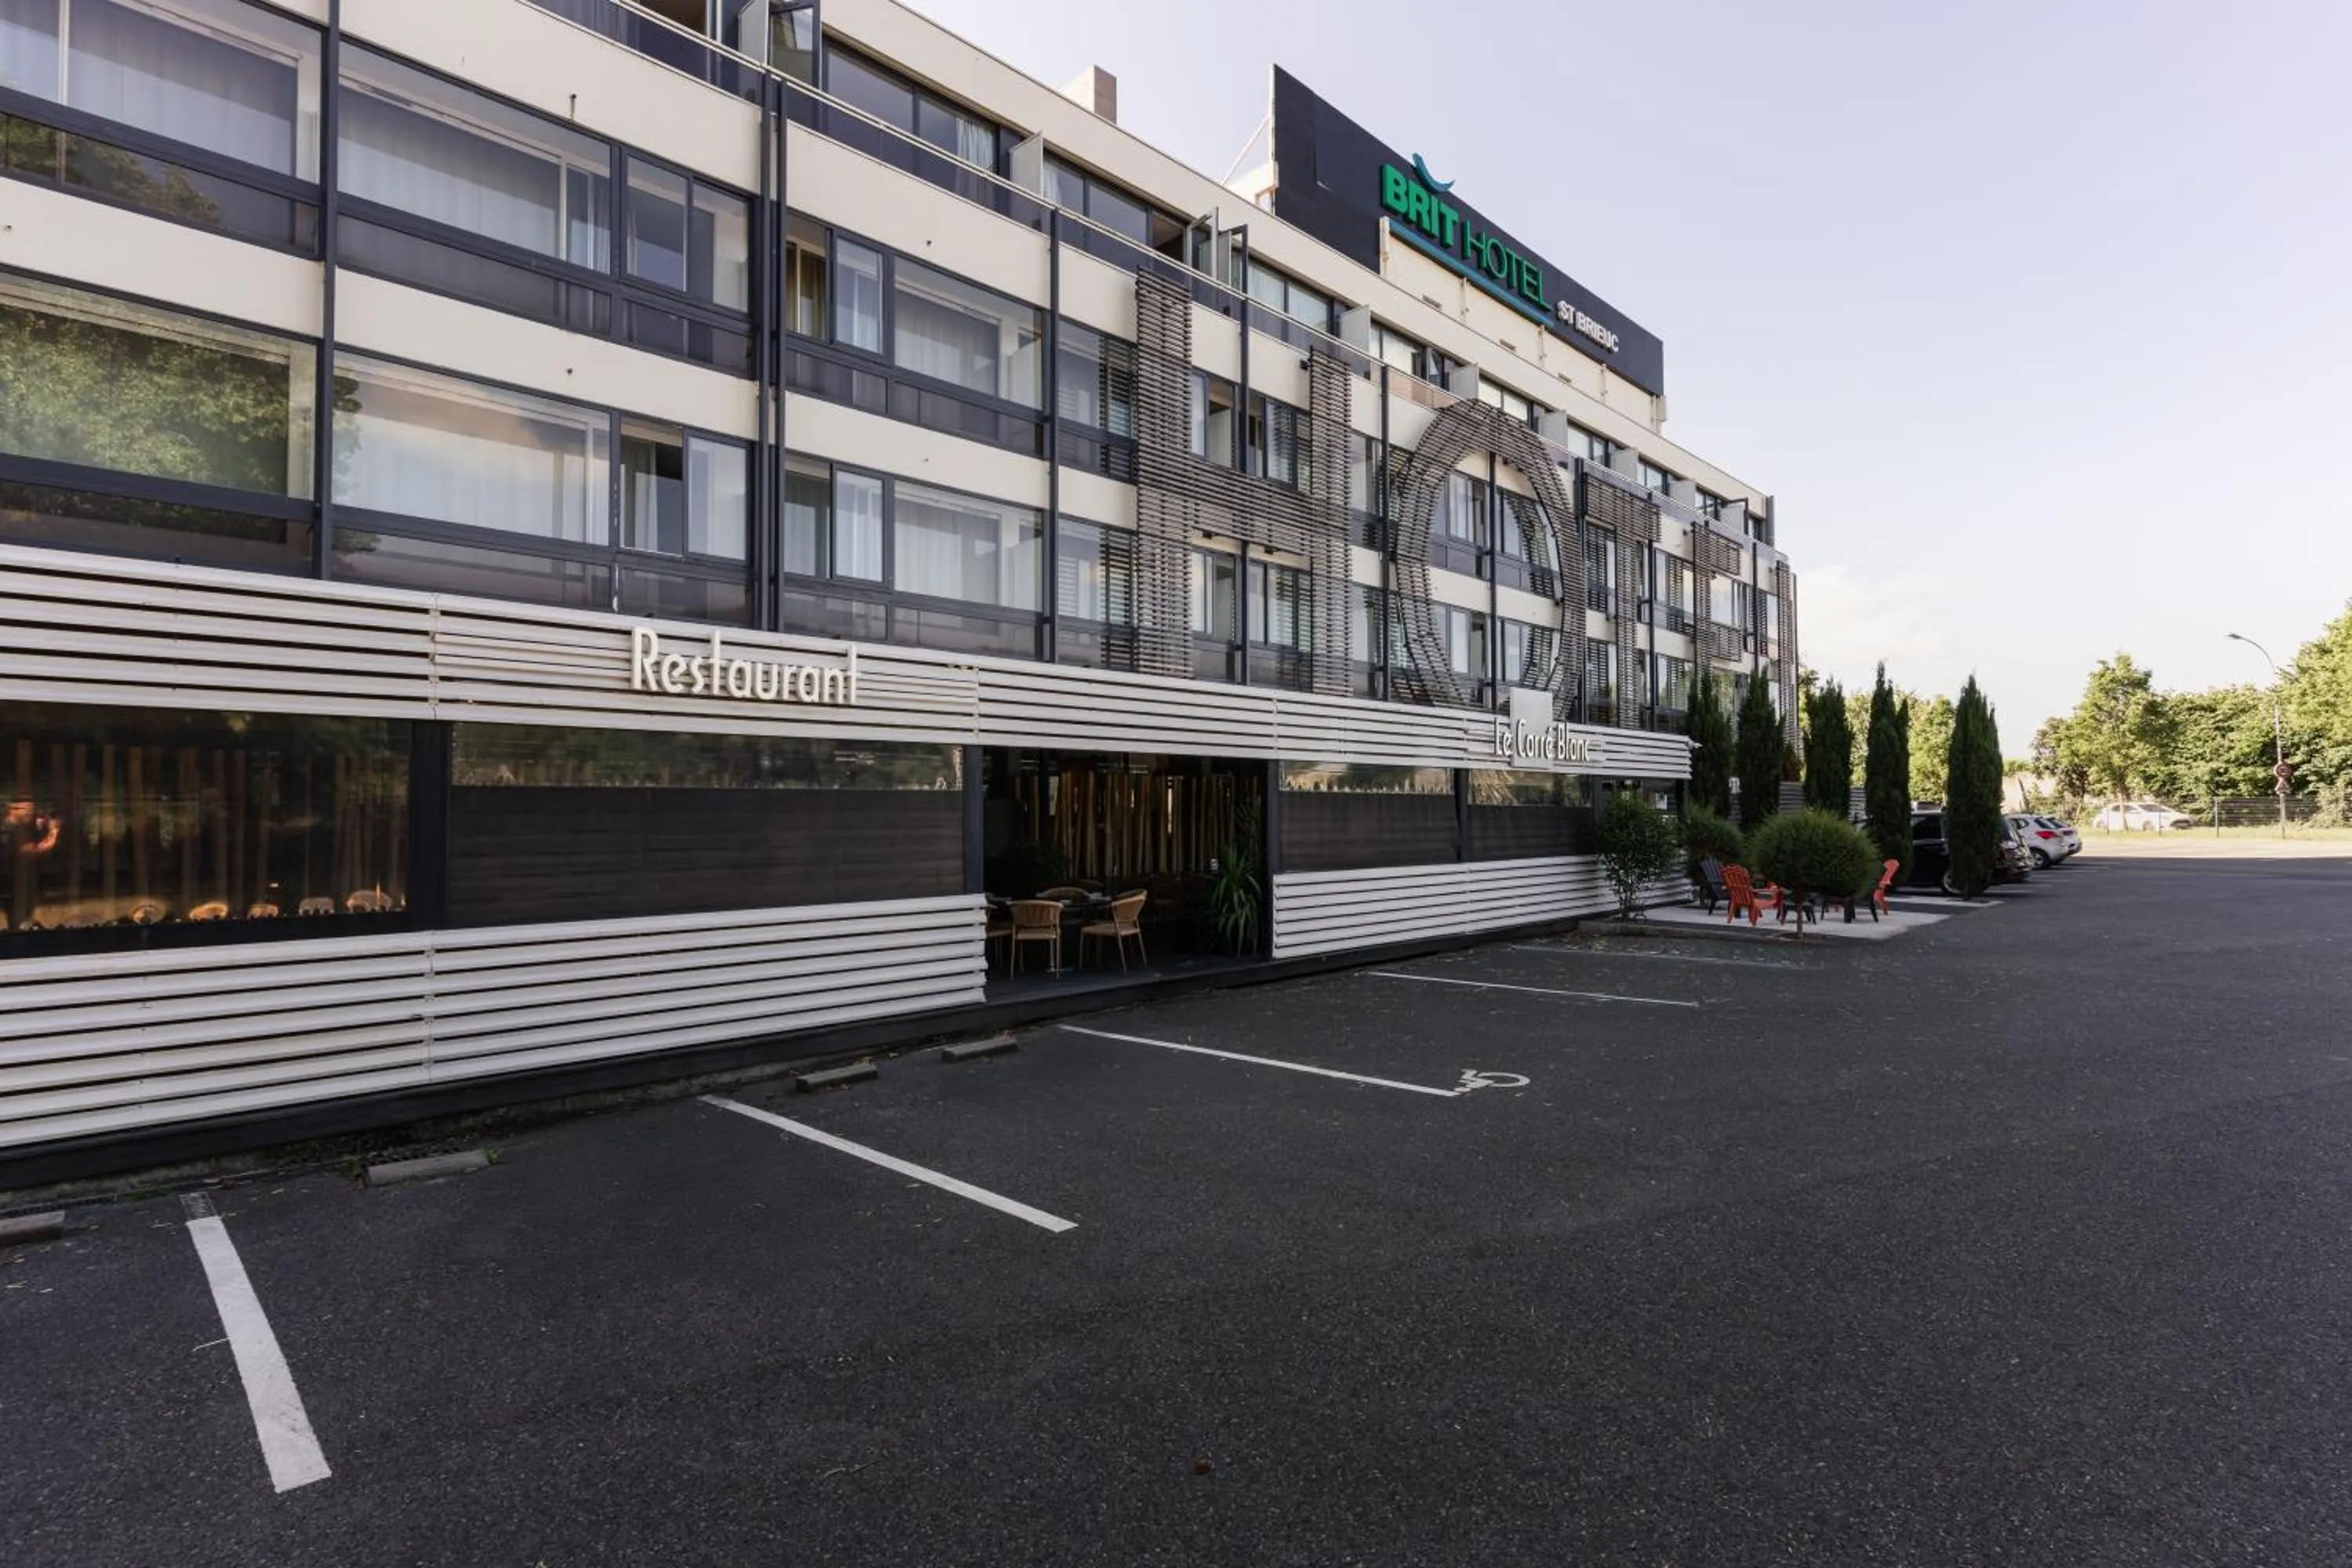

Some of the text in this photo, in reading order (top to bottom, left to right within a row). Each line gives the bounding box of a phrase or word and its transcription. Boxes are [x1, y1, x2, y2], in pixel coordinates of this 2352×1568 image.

[1381, 162, 1553, 311] BRIT HOTEL
[1556, 300, 1619, 352] ST BRIEUC
[631, 626, 857, 705] Restaurant
[1494, 717, 1591, 761] Le Carré Blanc
